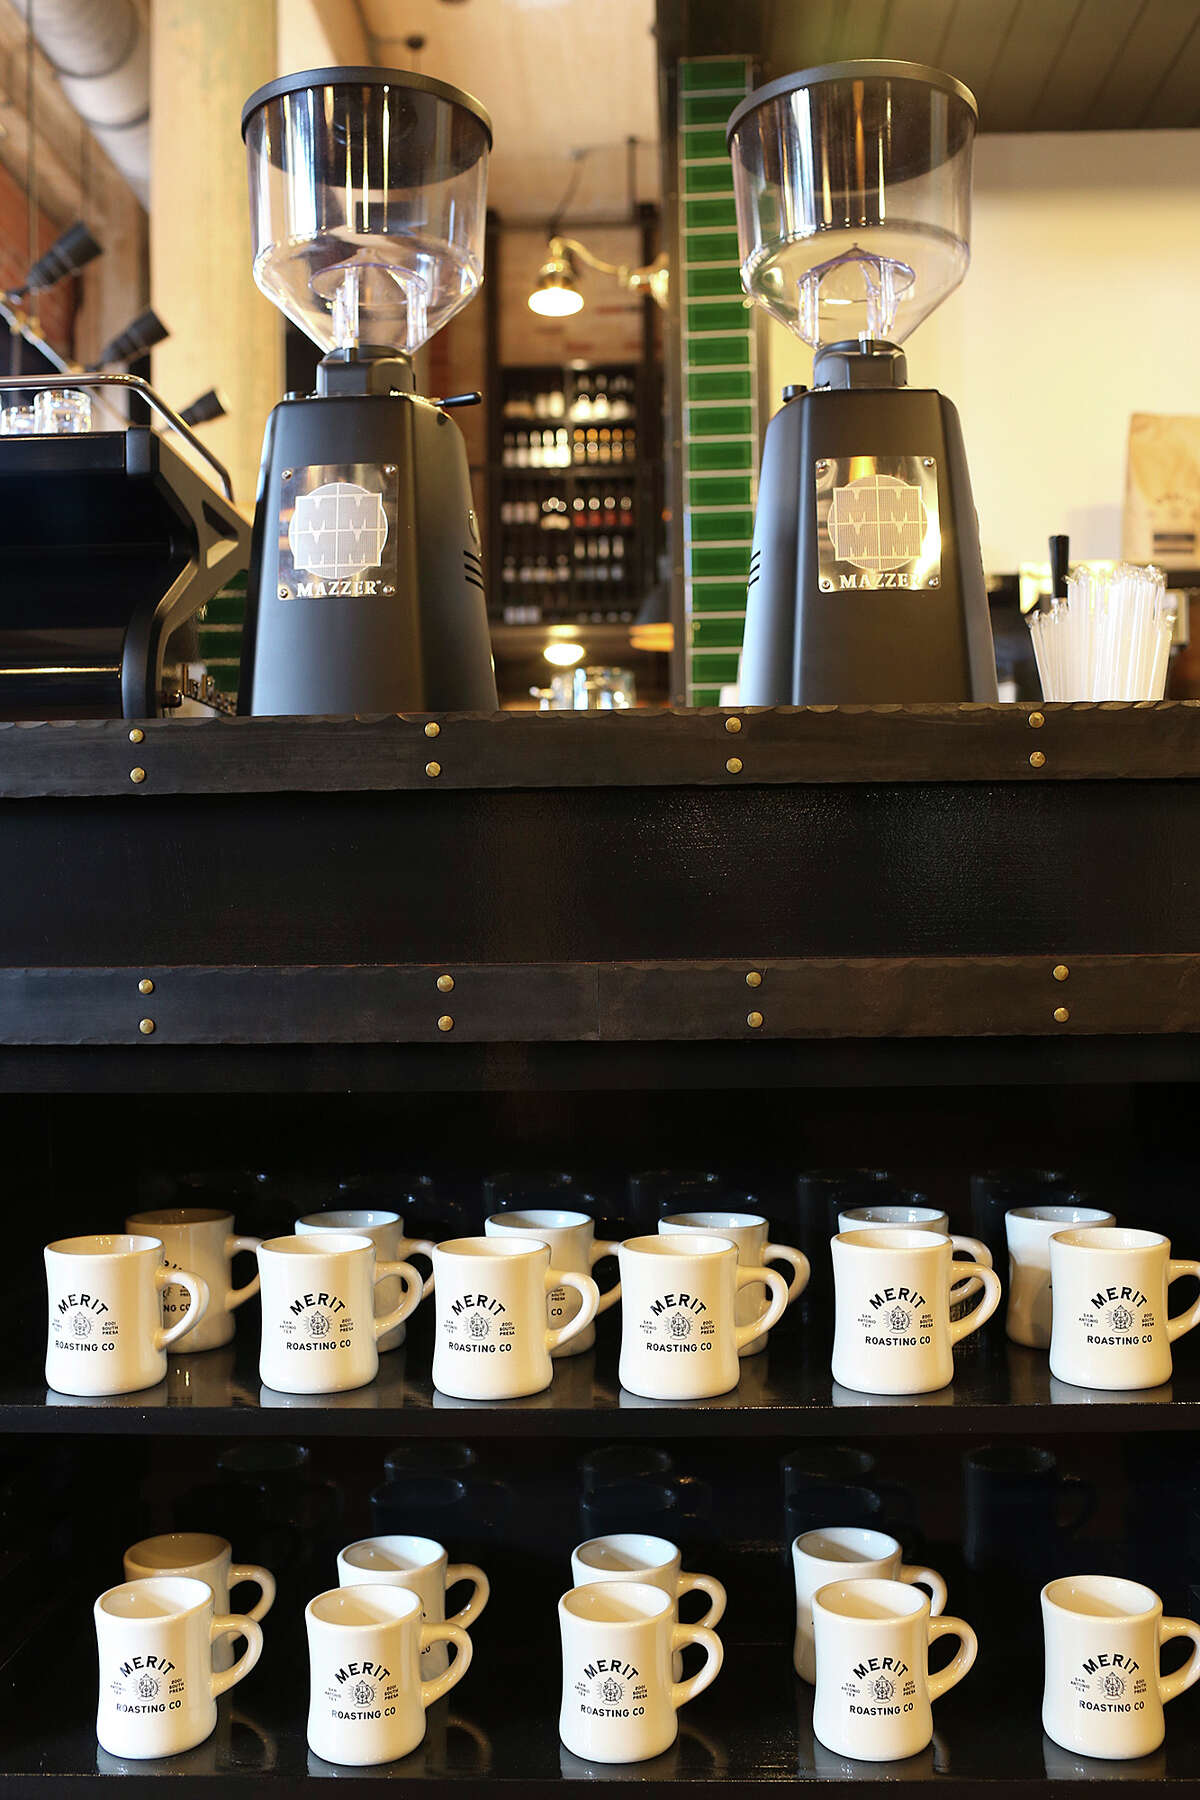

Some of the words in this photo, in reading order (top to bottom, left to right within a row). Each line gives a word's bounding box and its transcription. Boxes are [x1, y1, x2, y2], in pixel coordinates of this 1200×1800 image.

[296, 581, 377, 598] MAZZER
[58, 1294, 108, 1315] MERIT
[290, 1293, 345, 1315] MERIT
[452, 1294, 505, 1315] MERIT
[650, 1294, 706, 1316] MERIT
[869, 1288, 926, 1309] MERIT
[1091, 1287, 1147, 1309] MERIT
[551, 1308, 563, 1316] CO
[56, 1340, 98, 1351] ROASTING
[287, 1342, 336, 1350] ROASTING
[340, 1340, 350, 1348] CO
[449, 1342, 496, 1352] ROASTING
[647, 1343, 697, 1352] ROASTING
[866, 1336, 916, 1345] ROASTING
[920, 1336, 930, 1344] CO
[1087, 1336, 1139, 1345] ROASTING
[1142, 1335, 1152, 1343] CO
[120, 1656, 175, 1677] MERIT
[584, 1660, 638, 1680] MERIT
[853, 1657, 908, 1679] MERIT
[1082, 1654, 1139, 1675] MERIT
[335, 1662, 390, 1684] MERIT
[117, 1704, 165, 1713] ROASTING
[169, 1700, 181, 1709] CO
[332, 1710, 381, 1720] ROASTING
[385, 1707, 395, 1716] CO
[581, 1704, 629, 1717] ROASTING
[633, 1707, 644, 1716] CO
[850, 1705, 900, 1715] ROASTING
[904, 1703, 913, 1712] CO
[1080, 1700, 1130, 1712] ROASTING
[1134, 1701, 1144, 1710] CO
